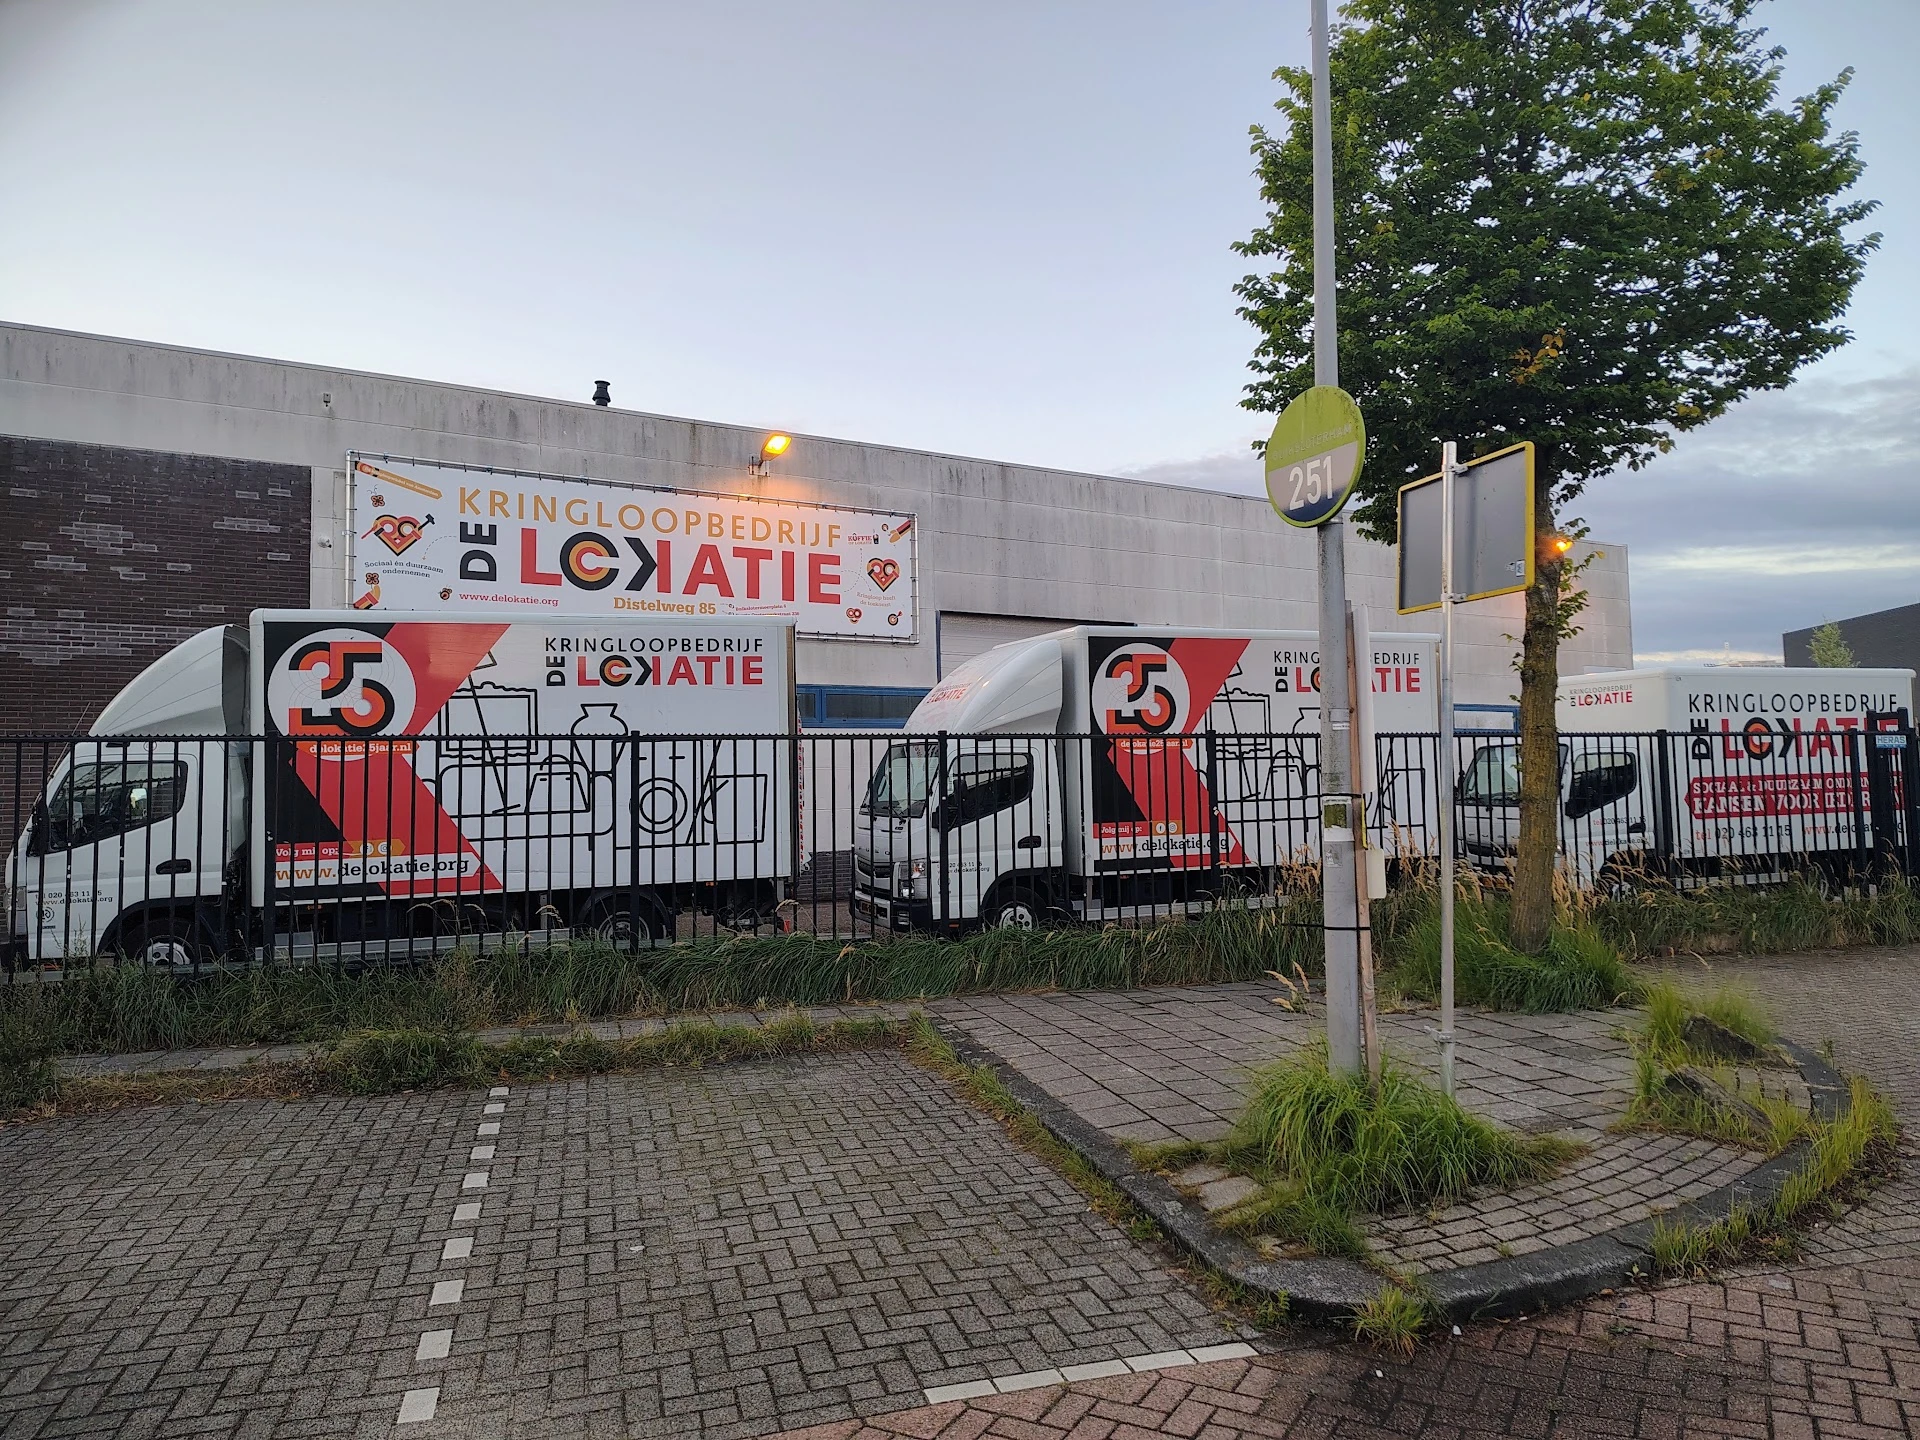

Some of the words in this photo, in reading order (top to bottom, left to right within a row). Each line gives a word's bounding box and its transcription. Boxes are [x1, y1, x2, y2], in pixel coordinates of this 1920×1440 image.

[1289, 455, 1333, 511] 251
[459, 486, 841, 548] KRINGLOOPBEDRIJF
[459, 521, 497, 582] DE
[364, 560, 393, 568] Sociaal
[405, 561, 444, 574] duurzaam
[382, 568, 431, 579] ondernemen
[459, 592, 559, 607] www.delokatie.org
[613, 597, 695, 615] Distelweg
[698, 602, 717, 615] 85
[545, 637, 763, 652] KRINGLOOPBEDRIJF
[1274, 651, 1420, 665] KRINGEDRIJF
[545, 655, 566, 687] DE
[1275, 666, 1289, 693] DE
[1689, 693, 1898, 713] KRINGLOOPBEDRIJF
[1690, 718, 1711, 760] DE
[1877, 736, 1906, 744] HERAS
[301, 846, 317, 856] mi
